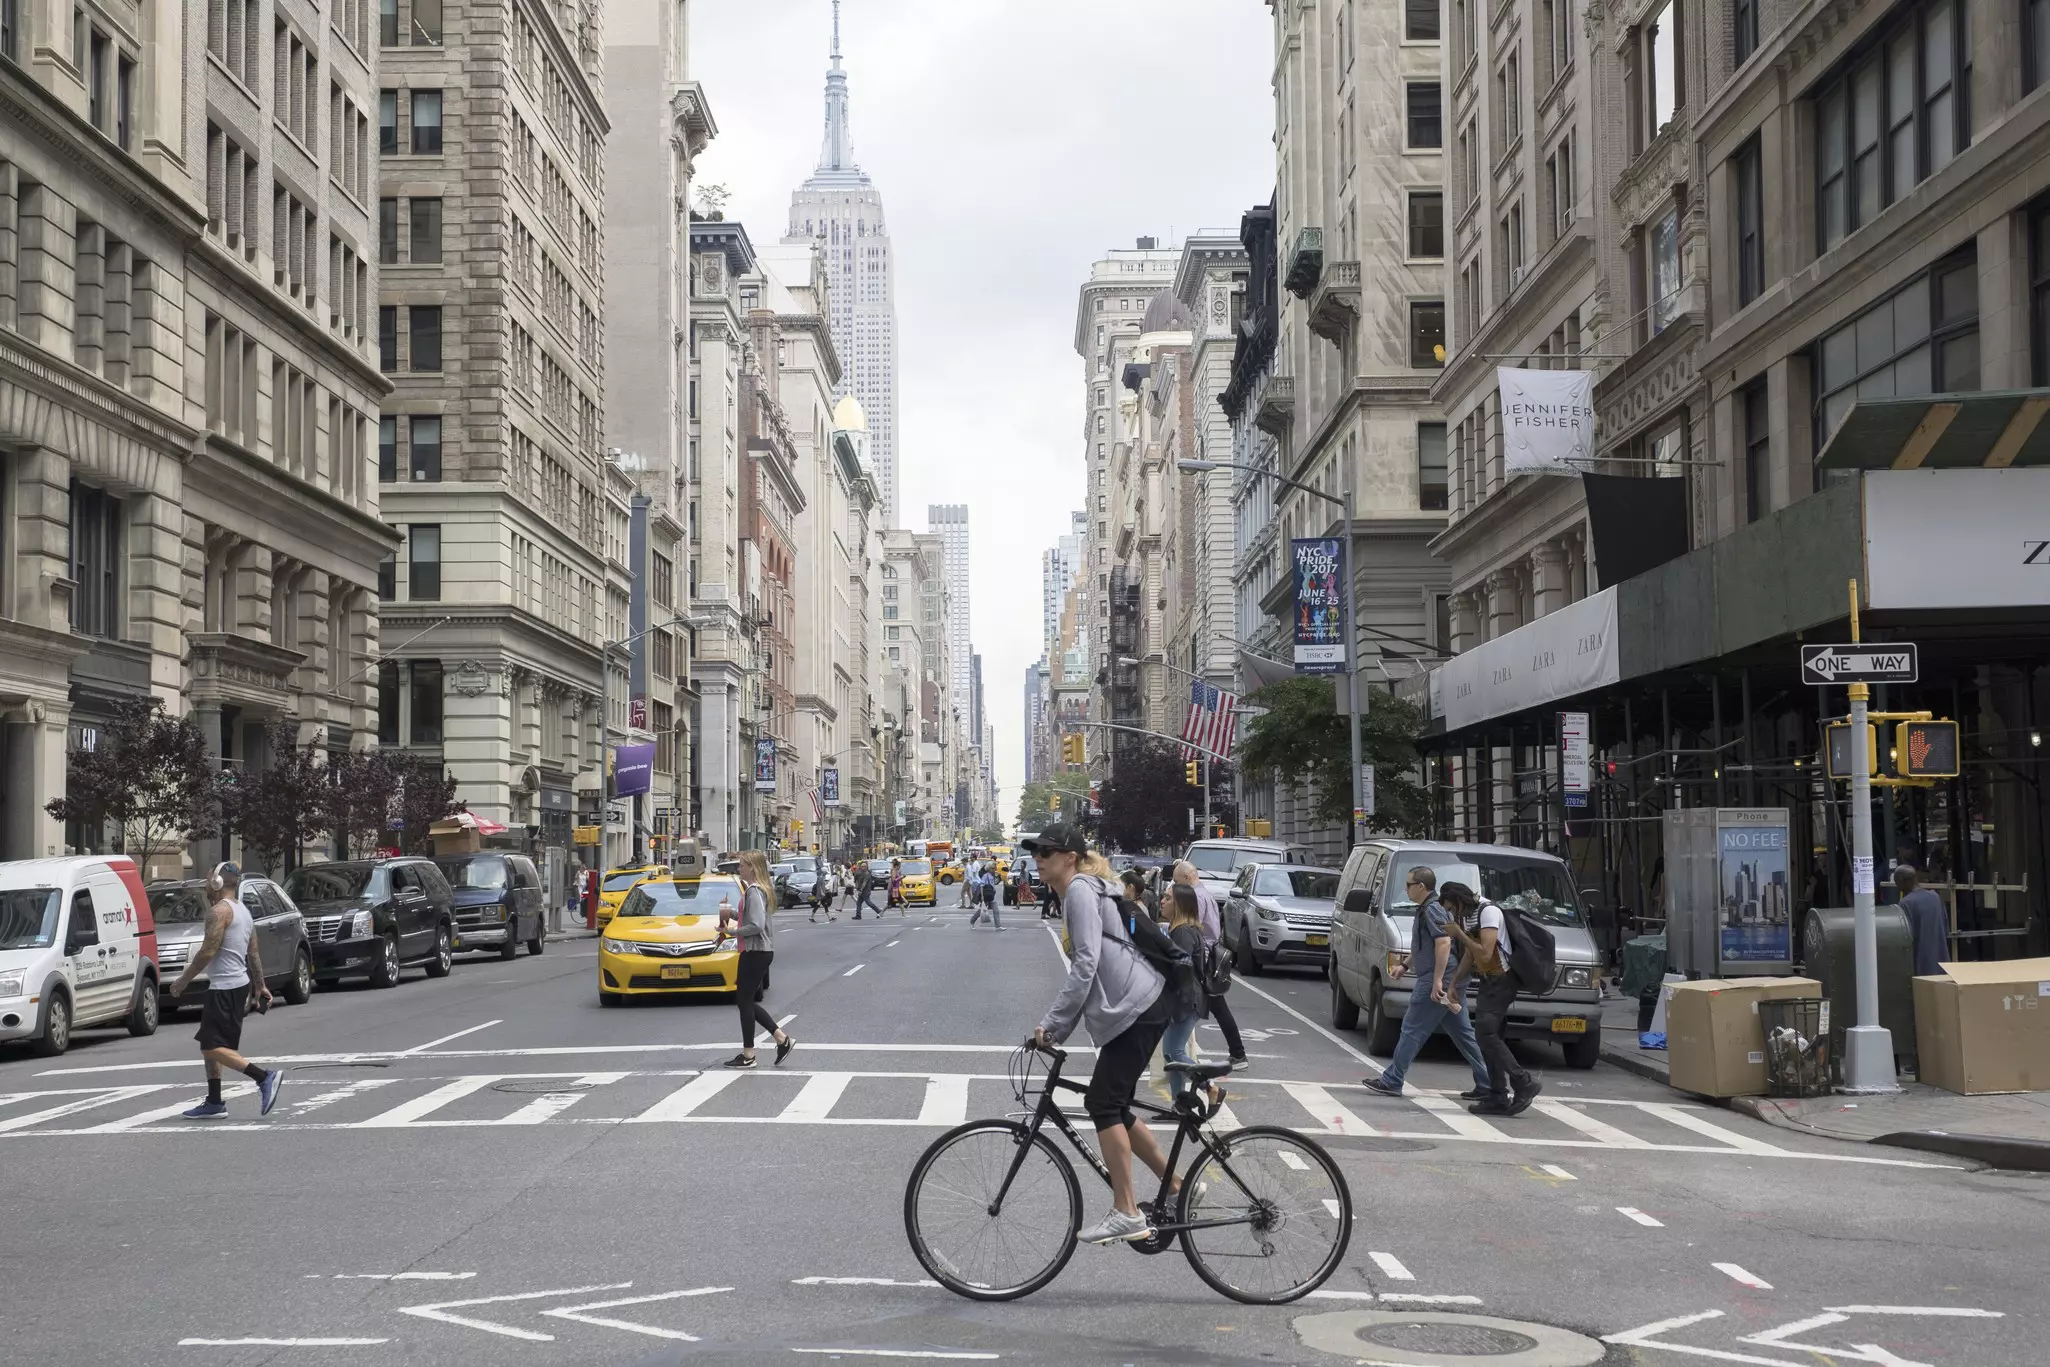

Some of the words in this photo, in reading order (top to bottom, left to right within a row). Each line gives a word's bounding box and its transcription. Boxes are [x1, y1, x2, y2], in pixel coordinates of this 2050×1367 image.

[1504, 404, 1592, 418] JENNIFER
[1515, 416, 1580, 429] FISHER
[1296, 546, 1320, 558] NYC
[1299, 556, 1333, 565] PRIDE
[1311, 564, 1338, 573] 2017
[1298, 589, 1326, 599] JUNE
[1311, 597, 1320, 605] 16
[1327, 597, 1339, 605] 25
[1577, 633, 1603, 655] ZARA
[1532, 651, 1555, 671] ZARA
[1815, 657, 1851, 671] ONE
[1871, 656, 1905, 670] WAY
[1493, 667, 1512, 685] ZARA
[1456, 682, 1472, 699] ZARA
[1737, 812, 1768, 820] Phone
[1724, 833, 1748, 847] NO
[1752, 833, 1779, 847] FEE
[103, 908, 126, 924] aramark
[1065, 1121, 1109, 1176] TREK
